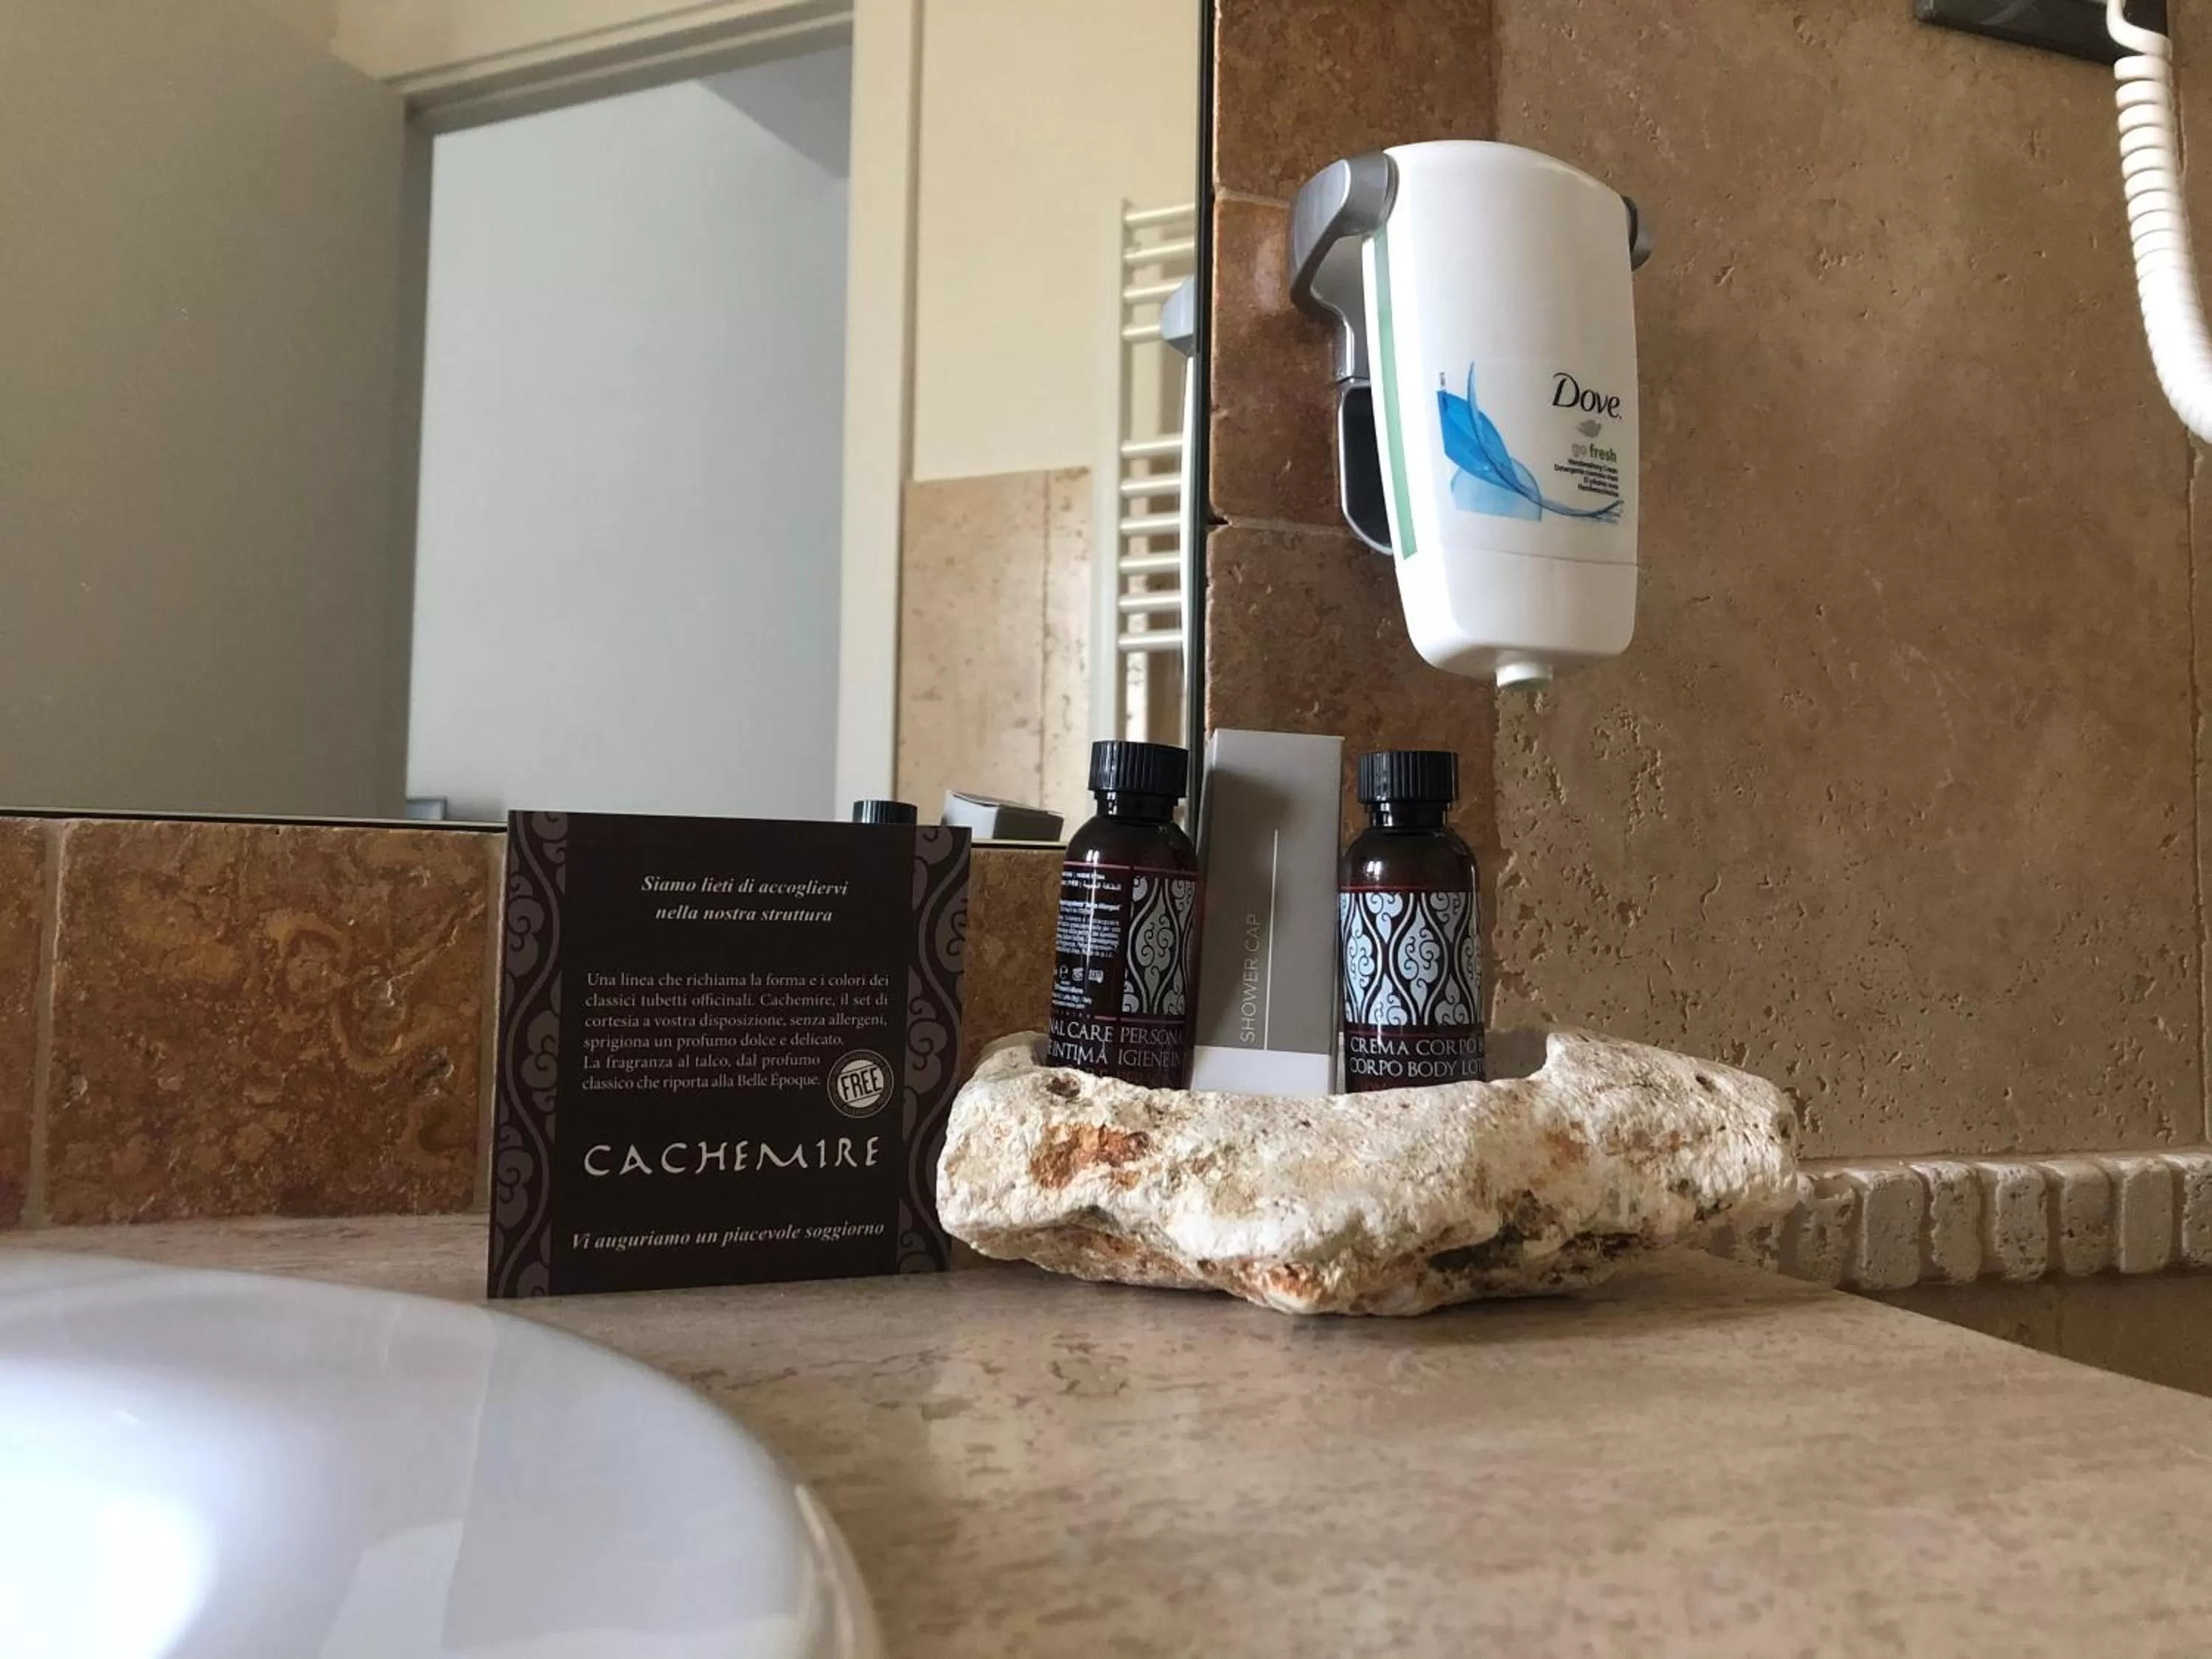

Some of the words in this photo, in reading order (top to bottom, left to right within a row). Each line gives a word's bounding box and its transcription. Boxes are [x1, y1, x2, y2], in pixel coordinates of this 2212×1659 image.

[1590, 443, 1617, 463] fresh
[641, 876, 696, 892] Siamo
[701, 877, 734, 893] lieti
[738, 879, 755, 894] di
[758, 880, 849, 898] accogliervi
[655, 905, 698, 919] nella
[703, 908, 756, 920] nostra
[761, 908, 832, 922] struttura
[1245, 913, 1261, 952] CAP
[588, 973, 616, 986] Una
[621, 973, 654, 986] linea
[658, 973, 683, 986] che
[686, 973, 746, 986] richiama
[751, 973, 762, 986] la
[766, 973, 805, 986] forma
[810, 977, 817, 986] e
[820, 974, 824, 986] i
[828, 973, 866, 986] colori
[869, 973, 889, 986] dei
[585, 993, 635, 1006] classici
[641, 992, 687, 1006] tubetti
[692, 993, 755, 1006] officinali.
[760, 994, 835, 1006] Cachemire,
[841, 994, 849, 1006] il
[853, 996, 870, 1006] set
[875, 993, 888, 1006] di
[1239, 959, 1259, 1043] SHOWER
[585, 1015, 639, 1027] cortesia
[643, 1018, 650, 1027] a
[654, 1016, 695, 1027] vostra
[700, 1012, 787, 1030] disposizione,
[790, 1017, 825, 1026] senza
[1068, 1021, 1114, 1042] CARE
[583, 1034, 650, 1052] sprigiona
[655, 1037, 672, 1047] un
[677, 1034, 737, 1050] profumo
[740, 1033, 776, 1046] dolce
[790, 1033, 844, 1046] delicato.
[1350, 1036, 1409, 1054] CREMA
[1416, 1038, 1477, 1056] CORPO
[584, 1055, 600, 1068] La
[606, 1054, 672, 1072] fragranza
[678, 1054, 689, 1068] al
[695, 1054, 731, 1068] talco,
[737, 1053, 757, 1066] dal
[762, 1053, 821, 1069] profumo
[1118, 1048, 1169, 1067] IGIENE
[1349, 1057, 1402, 1077] CORPO
[1408, 1061, 1458, 1077] BODY
[582, 1076, 633, 1089] classico
[637, 1075, 660, 1089] che
[664, 1075, 708, 1093] riporta
[712, 1073, 734, 1087] alla
[738, 1074, 768, 1086] Belle
[841, 1068, 883, 1100] FREE
[584, 1136, 880, 1176] CACHEMIRE
[572, 1233, 590, 1250] Vi
[594, 1229, 691, 1251] auguriamo
[695, 1231, 717, 1244] un
[721, 1223, 801, 1248] piacevole
[804, 1221, 885, 1242] soggiorno
